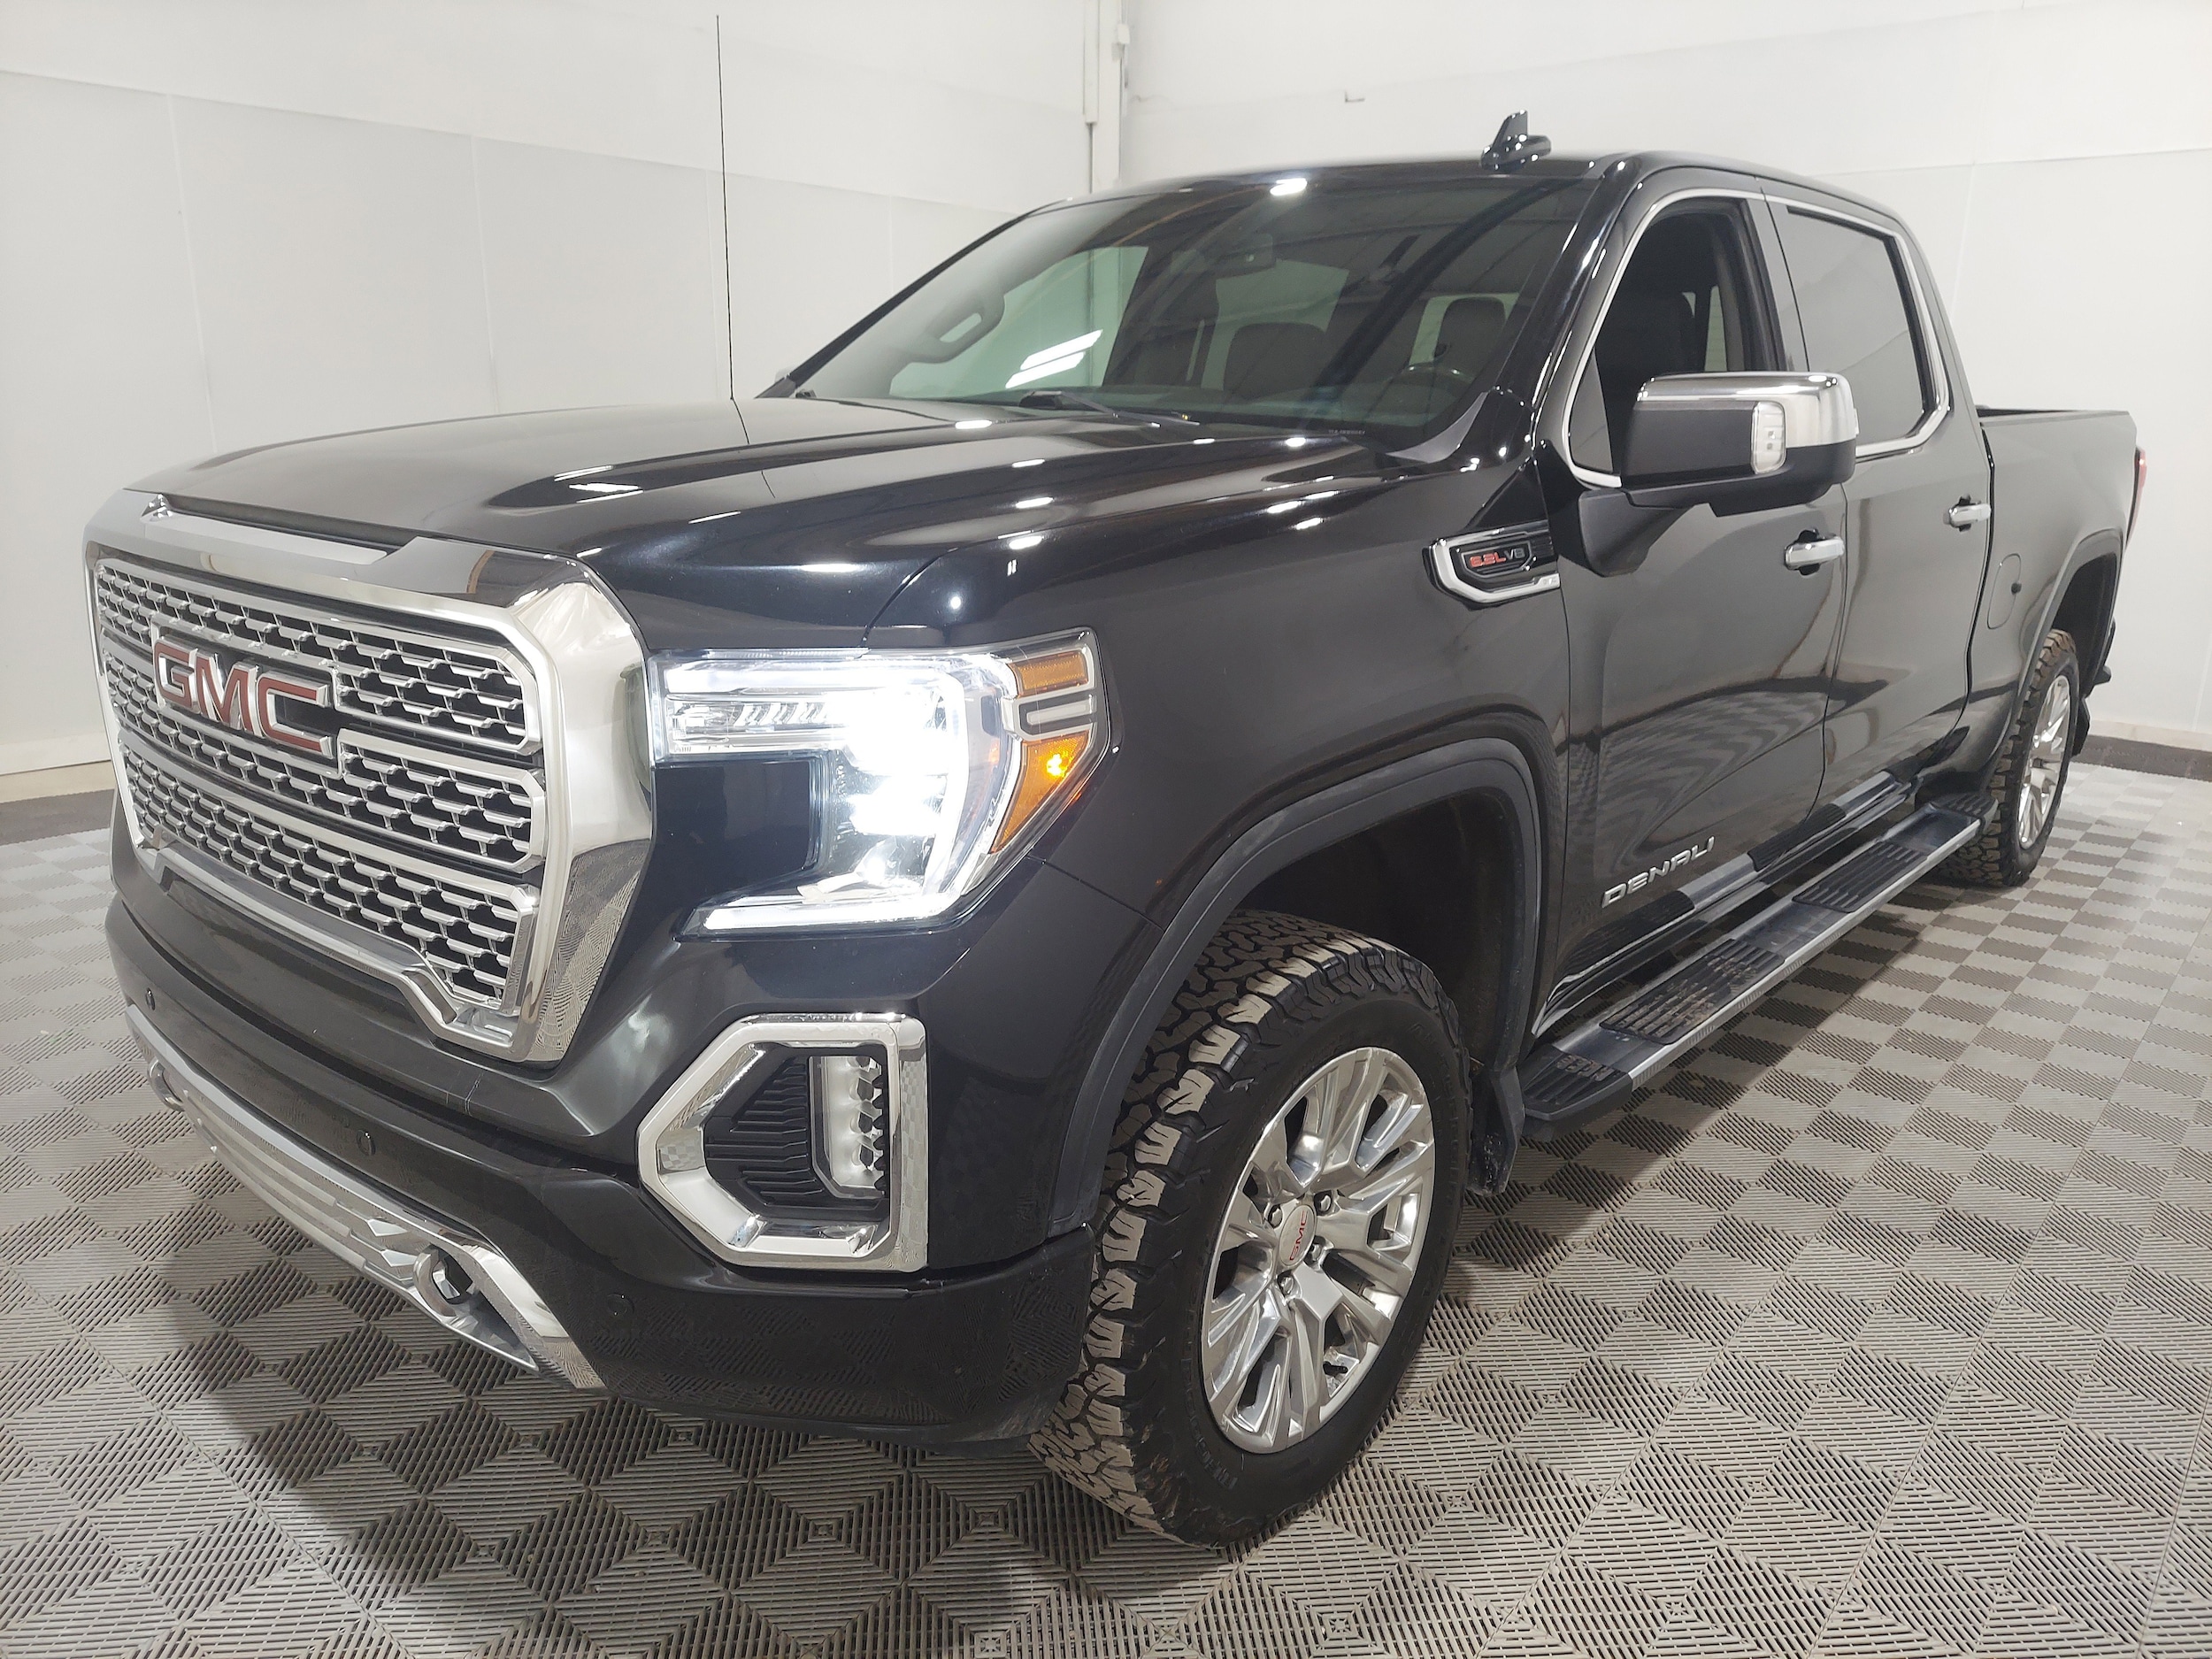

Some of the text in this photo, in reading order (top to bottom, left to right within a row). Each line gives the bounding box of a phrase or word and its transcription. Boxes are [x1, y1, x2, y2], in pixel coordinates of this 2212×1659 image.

[1469, 551, 1507, 568] 6.2L
[155, 636, 332, 758] GMC
[1601, 835, 1715, 909] DENALI
[1289, 1210, 1309, 1261] GMC
